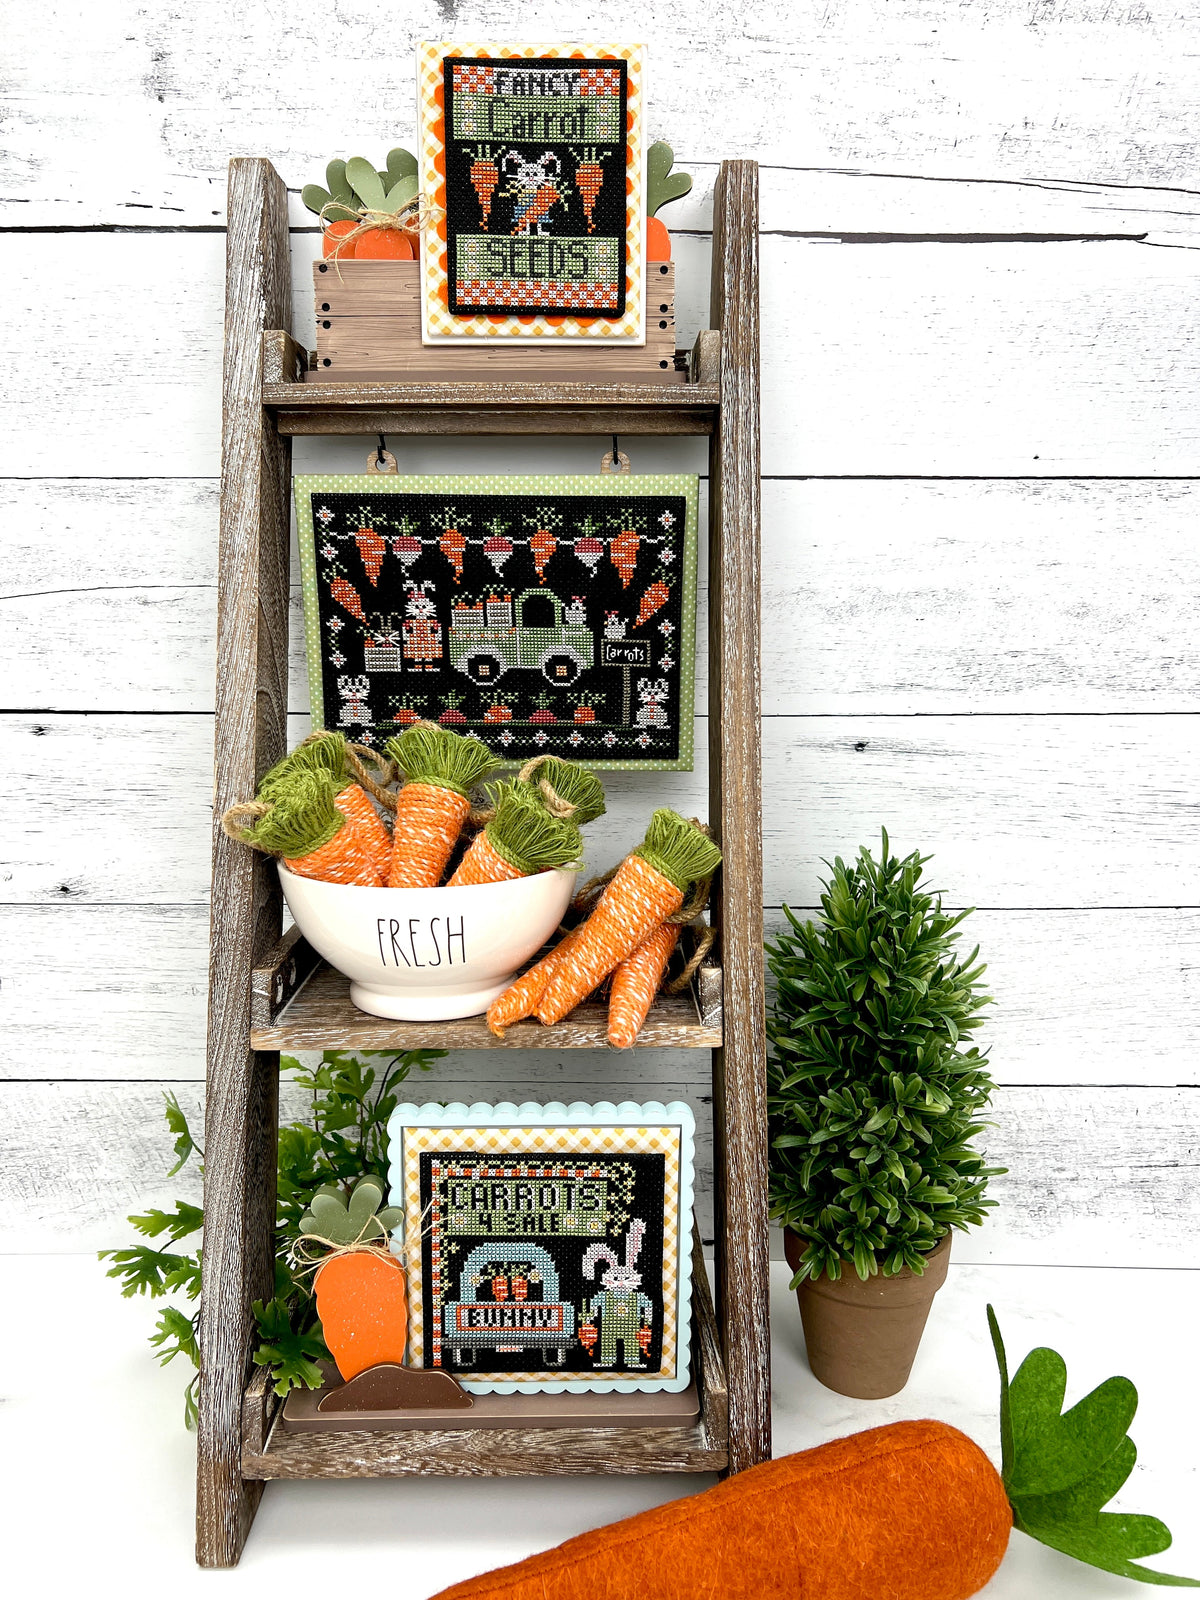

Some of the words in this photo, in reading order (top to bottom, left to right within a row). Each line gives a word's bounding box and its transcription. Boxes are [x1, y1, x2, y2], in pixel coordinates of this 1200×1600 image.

[495, 70, 580, 96] FANCY
[489, 99, 589, 137] Carrot
[487, 238, 588, 279] SEEDS
[606, 644, 644, 661] Carrots
[377, 915, 466, 968] FRESH
[452, 1183, 602, 1212] CARROTS
[479, 1213, 492, 1232] 4
[506, 1213, 561, 1233] SALE
[468, 1307, 553, 1328] BUNNY
